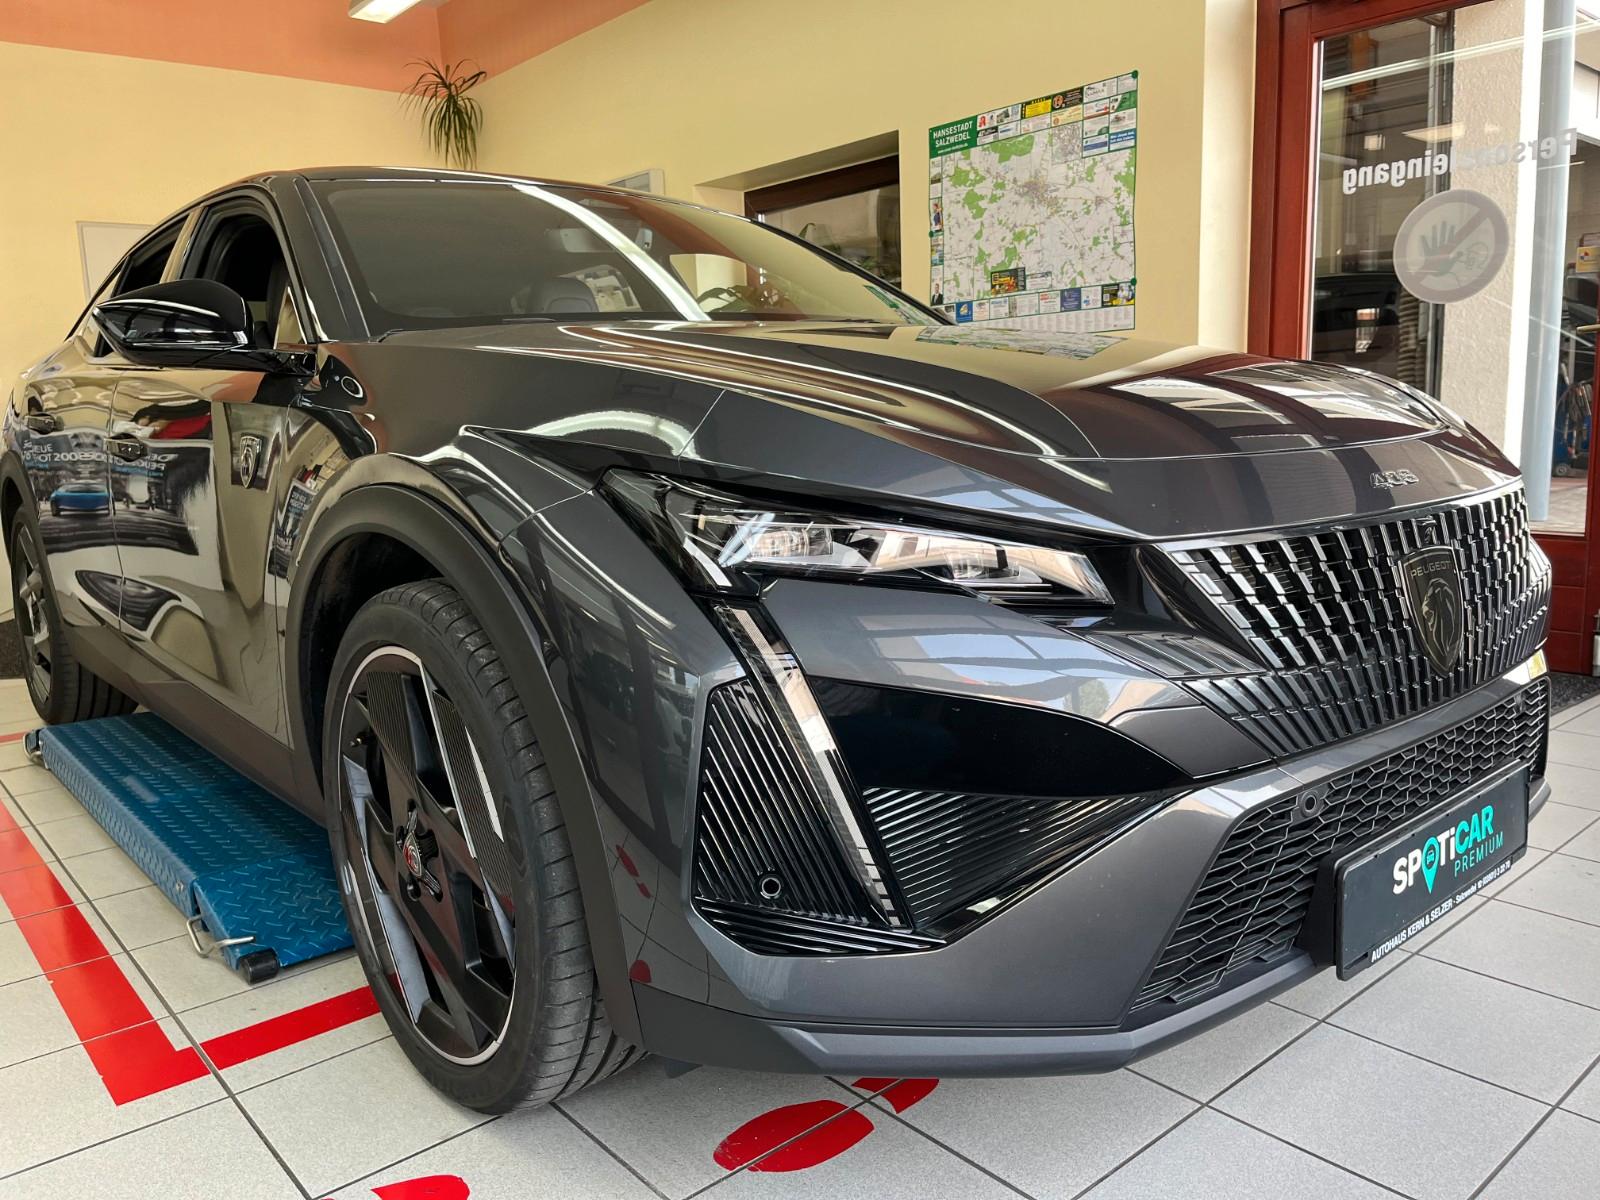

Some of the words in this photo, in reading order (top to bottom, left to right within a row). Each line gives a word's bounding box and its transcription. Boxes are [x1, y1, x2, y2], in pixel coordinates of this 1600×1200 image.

[933, 120, 973, 139] HANSESTADT
[935, 131, 971, 148] SALZWEDEL
[1410, 560, 1452, 580] PEUGEOT
[1454, 831, 1505, 878] PREMIUM
[1370, 929, 1407, 963] AUTOHAUS
[1407, 917, 1425, 938] KERN
[1430, 898, 1453, 921] SELZER
